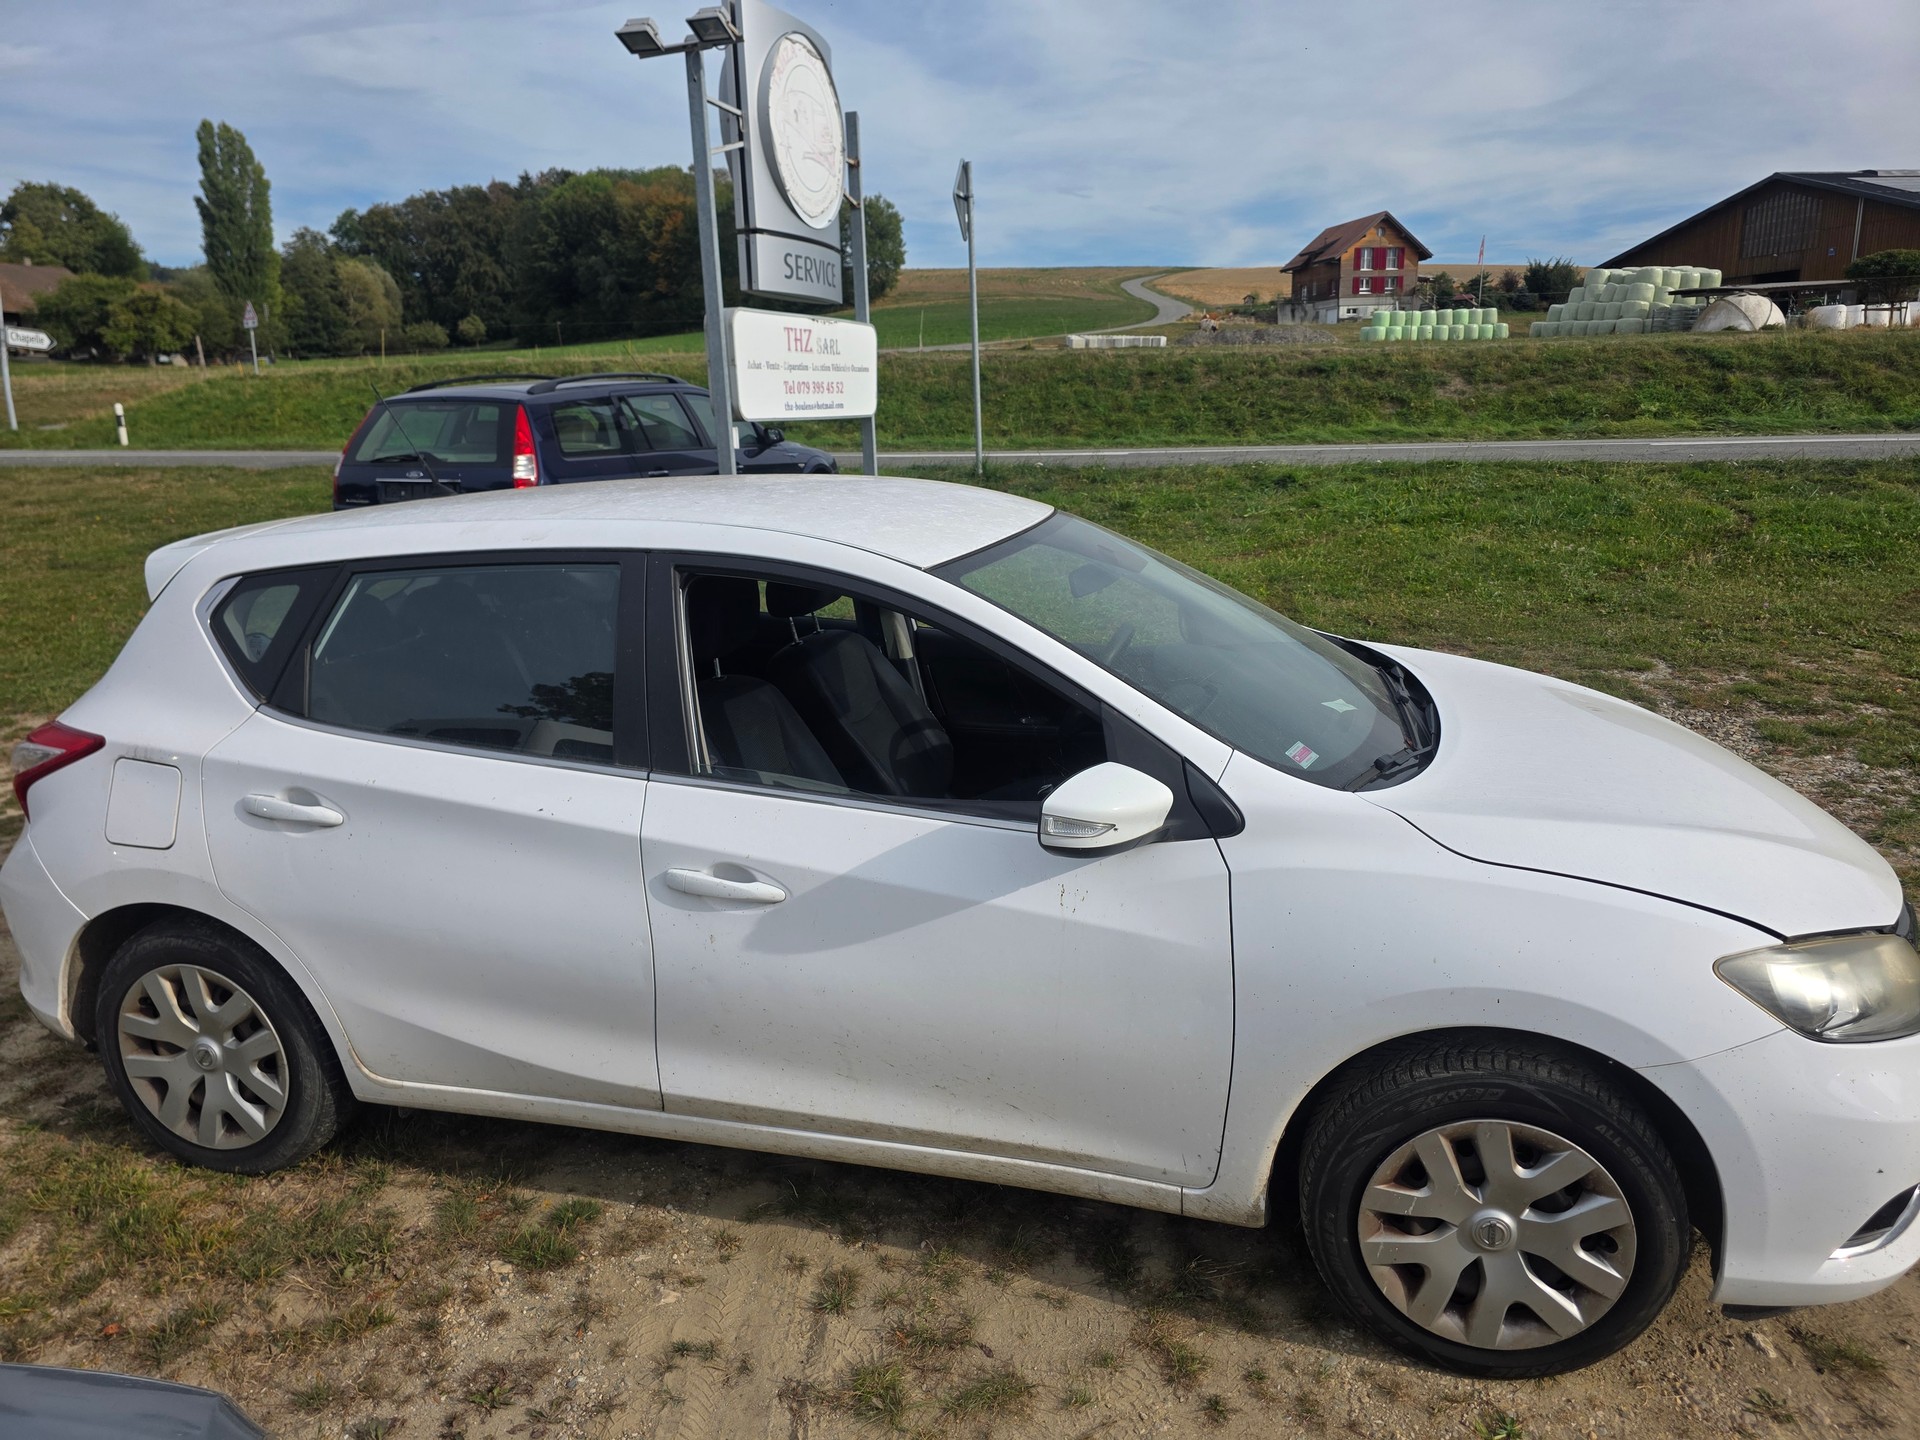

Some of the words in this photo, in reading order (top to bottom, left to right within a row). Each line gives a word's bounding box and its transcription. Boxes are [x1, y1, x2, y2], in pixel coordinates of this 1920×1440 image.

[784, 252, 837, 289] SERVICE
[10, 331, 46, 346] Chapelle
[783, 327, 814, 352] THZ
[816, 337, 841, 355] SARL
[783, 380, 796, 394] Tel
[797, 381, 811, 394] 079
[812, 381, 825, 394] 395
[826, 381, 834, 394] 45
[835, 381, 844, 394] 52
[1594, 1124, 1622, 1147] ALL
